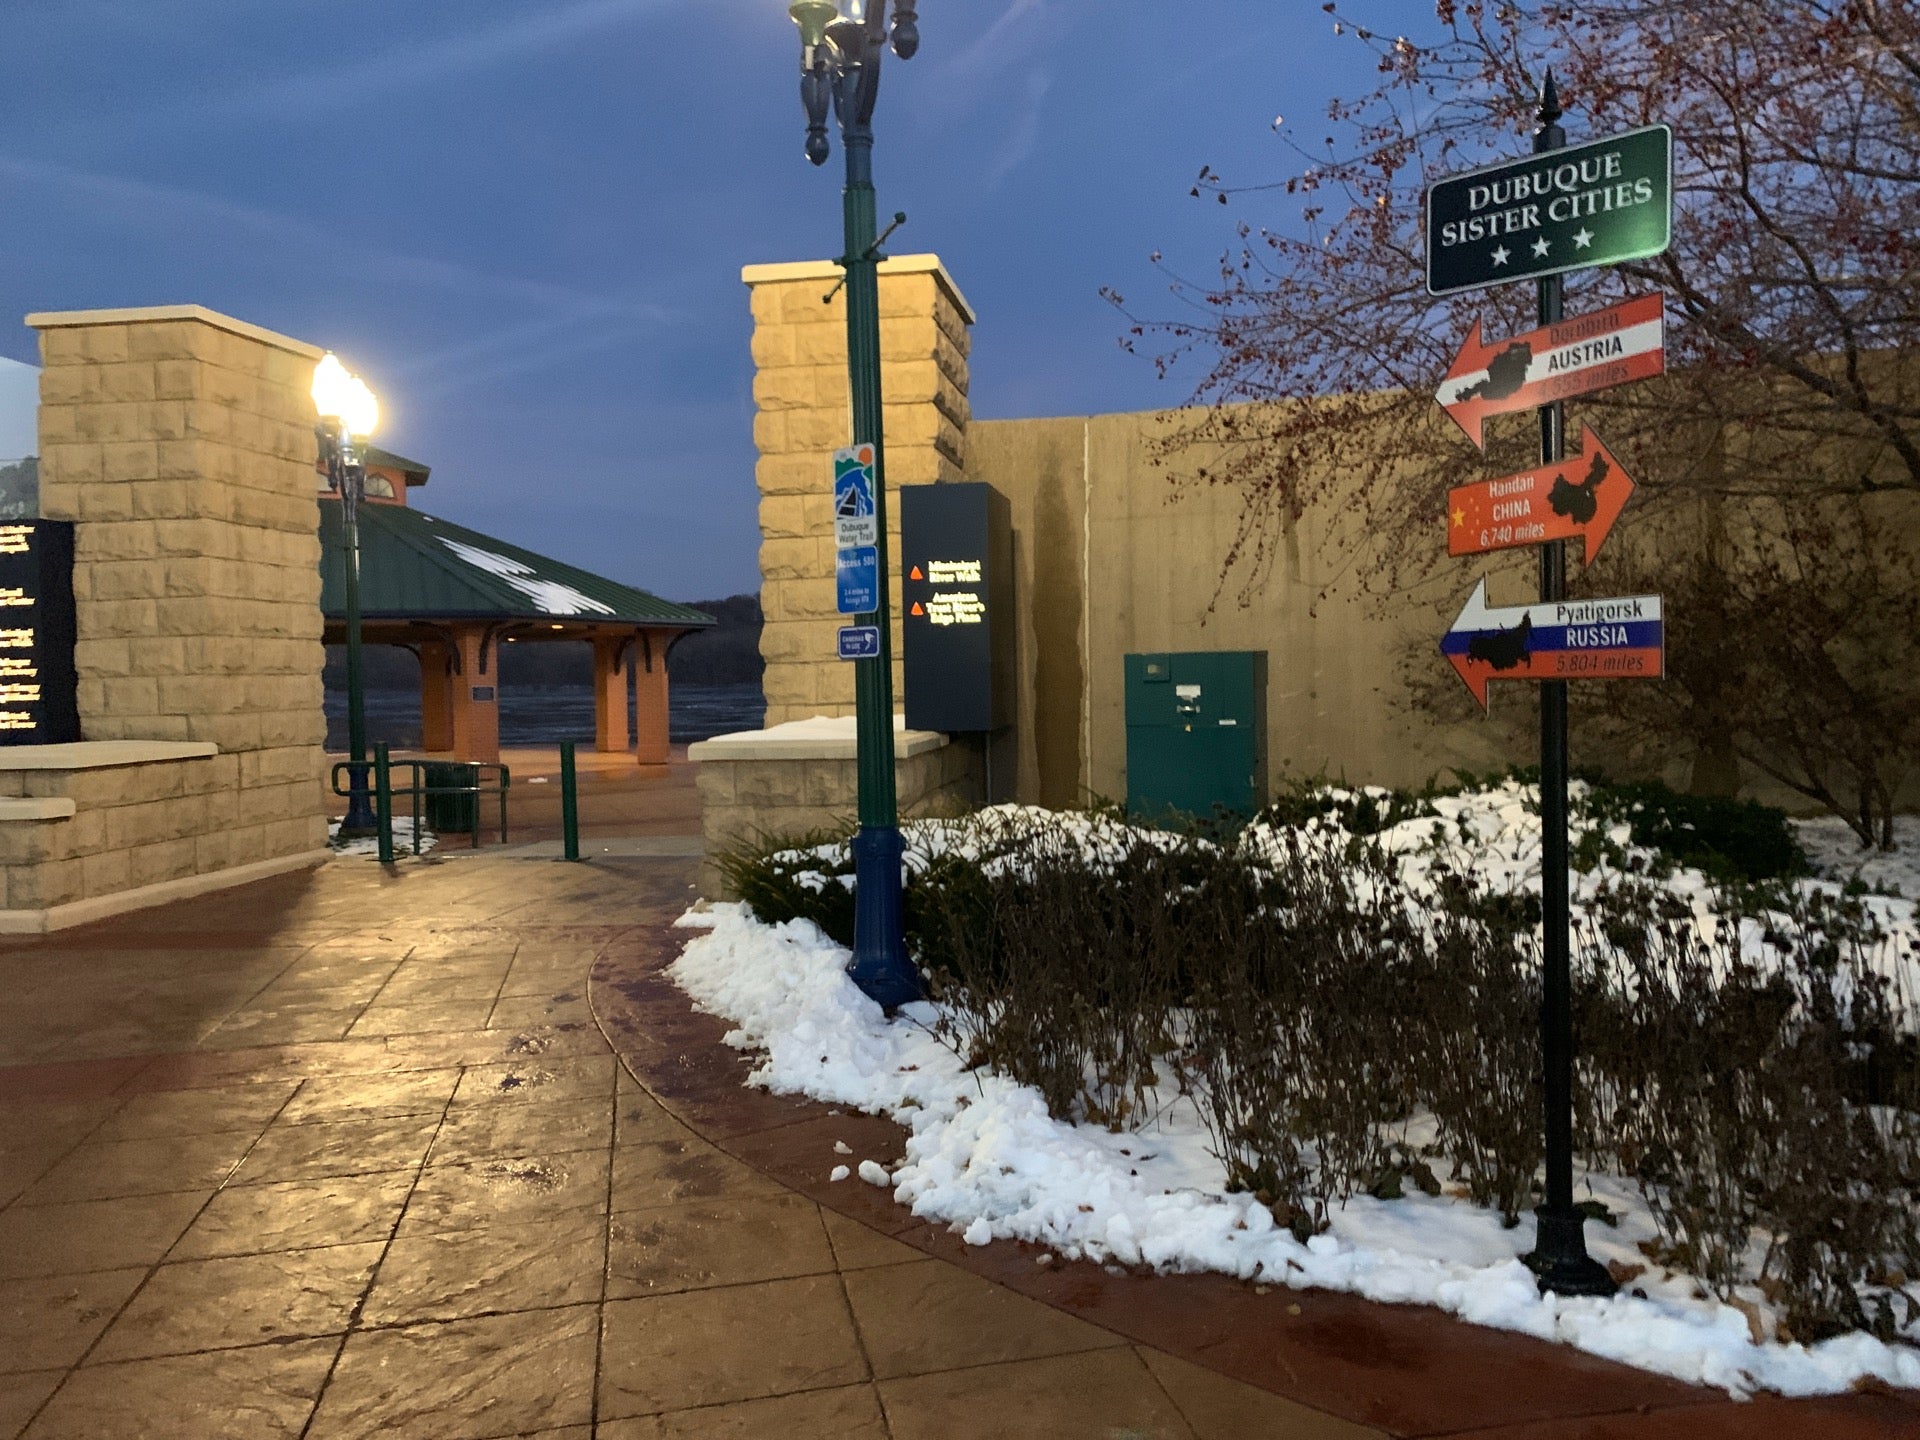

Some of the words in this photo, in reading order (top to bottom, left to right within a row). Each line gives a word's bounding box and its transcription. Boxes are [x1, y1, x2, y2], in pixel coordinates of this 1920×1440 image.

[1468, 152, 1622, 211] DUBUQUE
[1442, 203, 1542, 247] SISTER
[1548, 178, 1653, 222] CITIES
[1548, 336, 1623, 373] AUSTRIA
[1586, 364, 1629, 386] miles
[1489, 475, 1535, 498] Handan
[1493, 499, 1531, 522] CHINA
[839, 533, 857, 543] Water
[841, 523, 869, 533] Dubuque
[1515, 521, 1545, 541] miles
[838, 558, 861, 569] Access
[1557, 600, 1643, 625] Pyatigorsk
[1566, 626, 1628, 647] RUSSIA
[1603, 655, 1643, 671] miles
